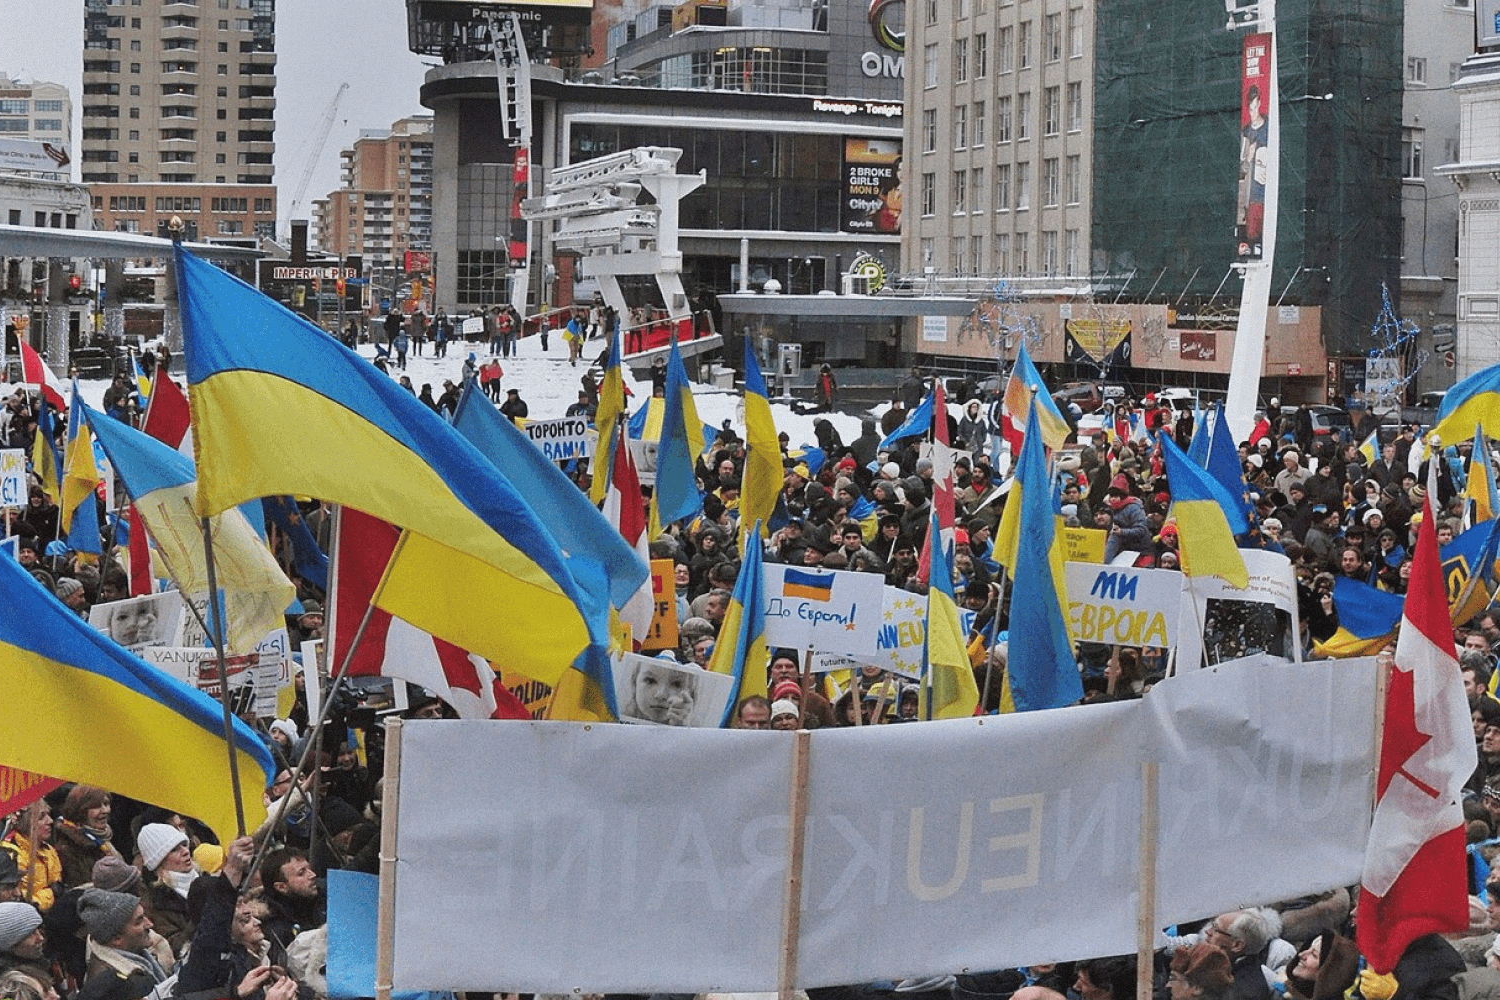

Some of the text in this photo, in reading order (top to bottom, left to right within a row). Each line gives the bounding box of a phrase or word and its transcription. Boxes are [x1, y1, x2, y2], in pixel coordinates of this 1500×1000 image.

[473, 8, 542, 21] Panasonic
[814, 100, 857, 115] Revenge
[865, 104, 902, 117] Tonight
[850, 168, 892, 177] 2 BROKE
[850, 177, 879, 186] GIRLS
[850, 186, 872, 195] MON
[274, 267, 329, 279] IMPERL
[526, 420, 585, 440] ТОРОНТО
[1090, 570, 1139, 602] МИ
[765, 598, 791, 617] До
